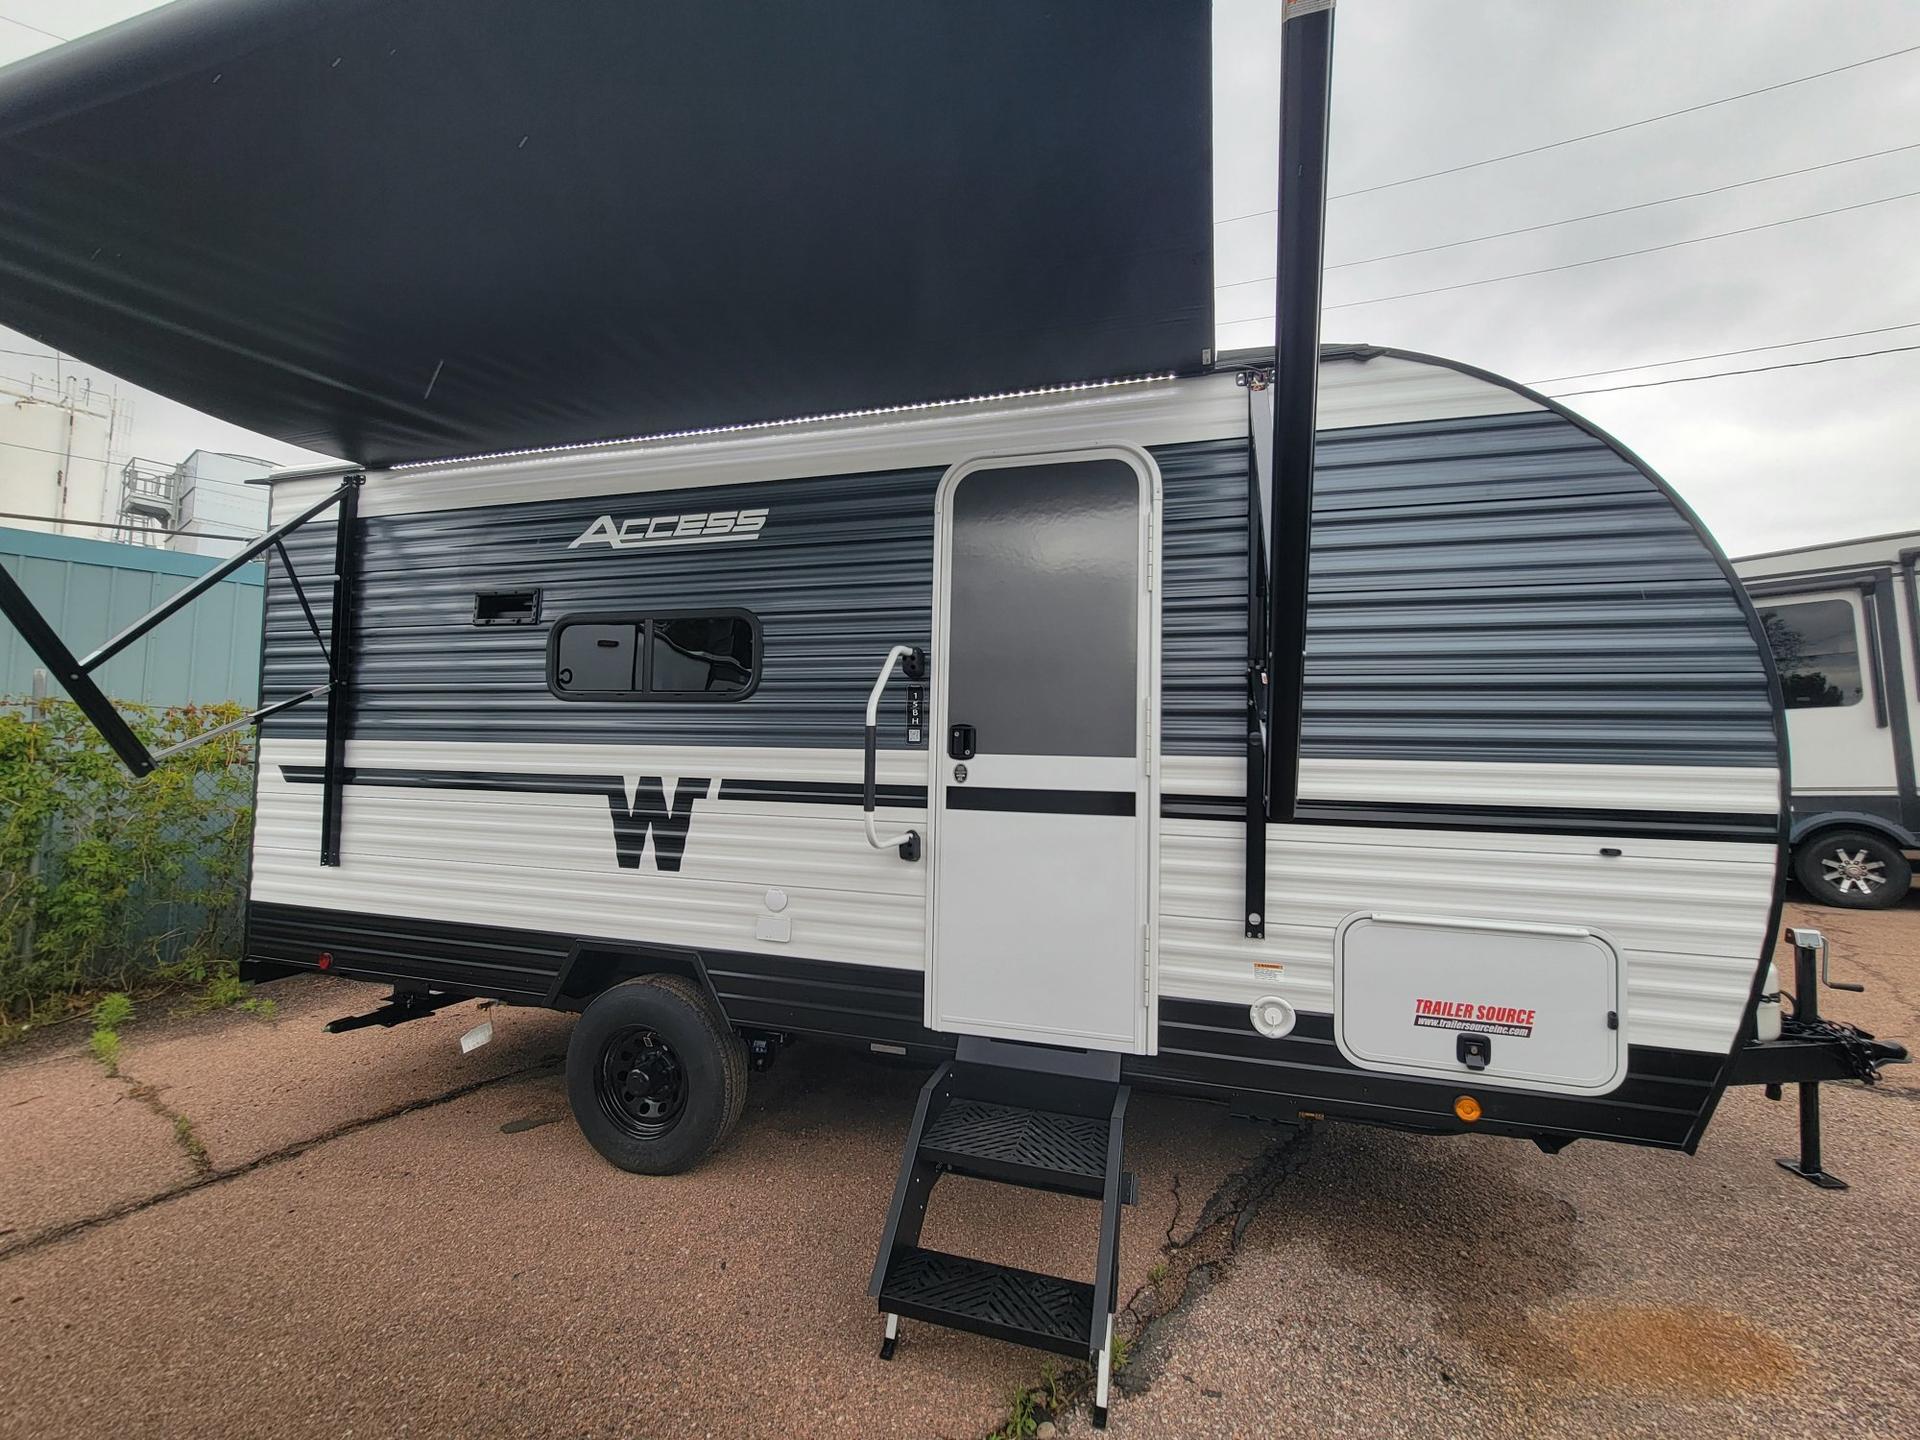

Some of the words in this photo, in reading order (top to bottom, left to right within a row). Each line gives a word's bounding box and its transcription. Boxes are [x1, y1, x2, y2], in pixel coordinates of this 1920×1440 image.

[607, 775, 711, 872] W
[1415, 998, 1474, 1019] TRAILER
[1476, 1004, 1536, 1025] SOURCE
[1417, 1016, 1529, 1037] www.trailersourceinc.com
